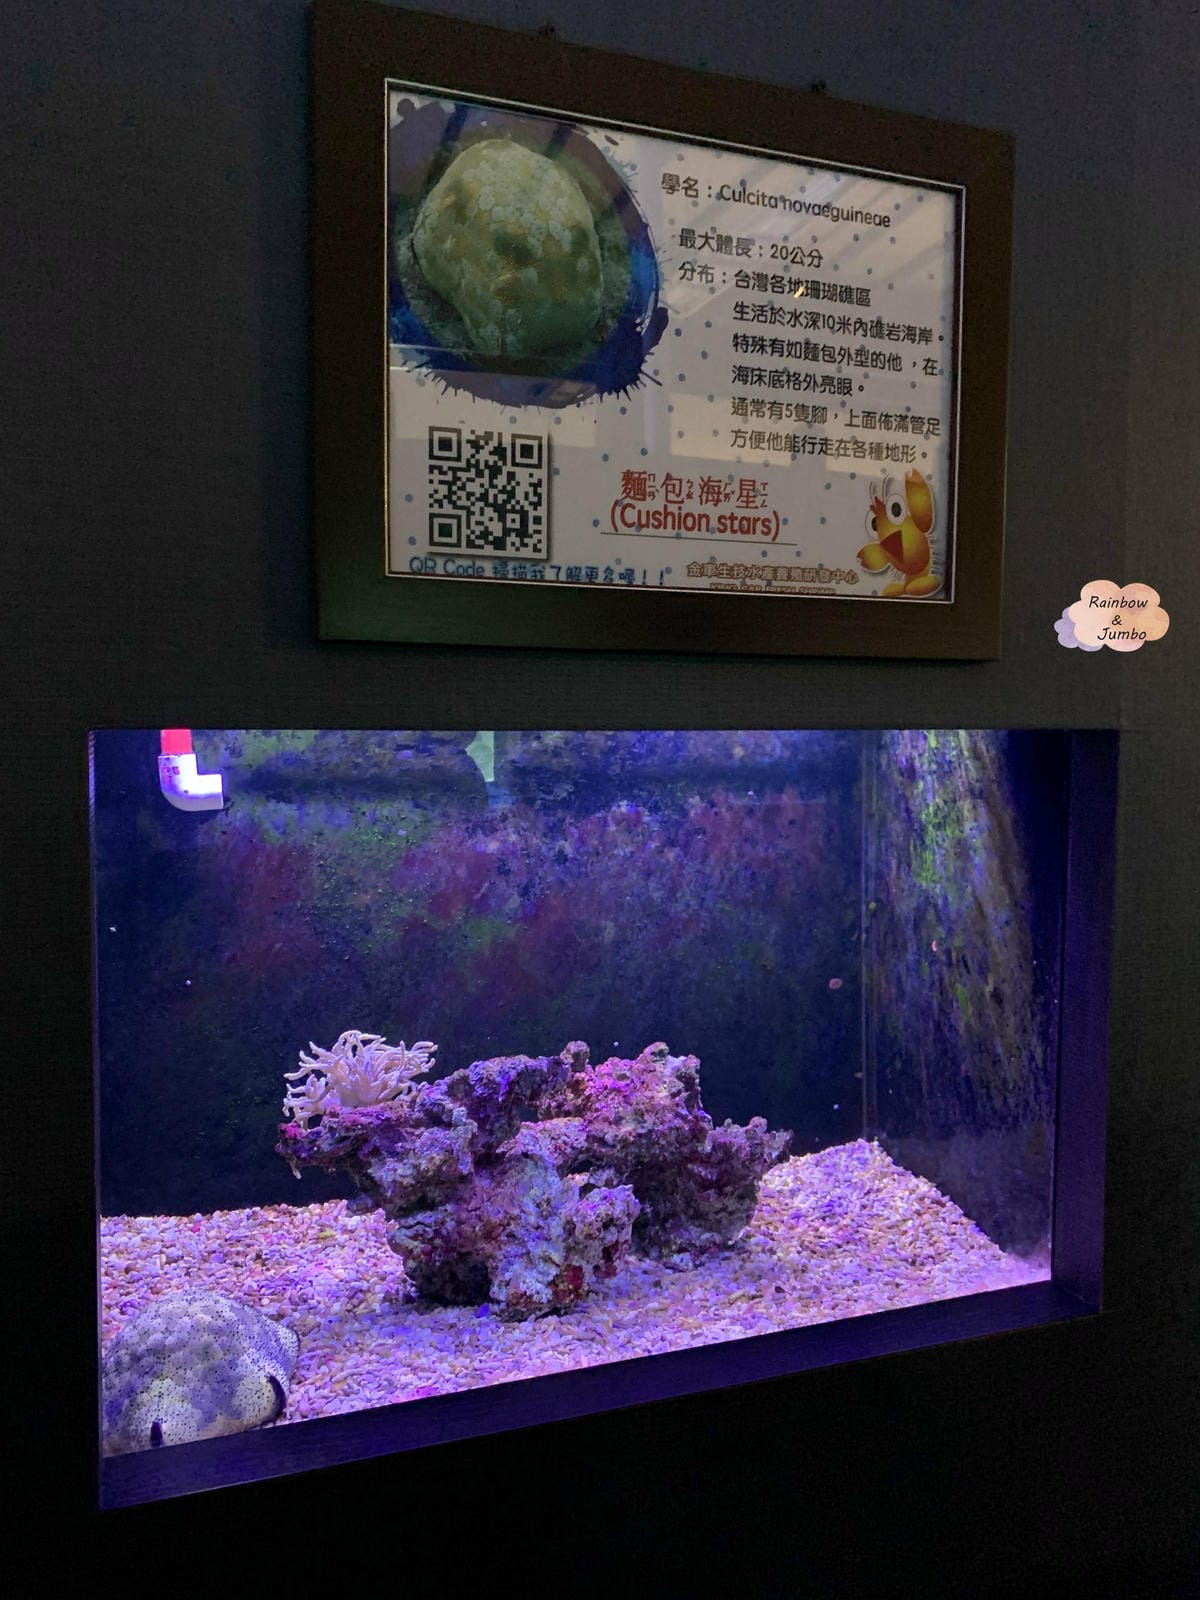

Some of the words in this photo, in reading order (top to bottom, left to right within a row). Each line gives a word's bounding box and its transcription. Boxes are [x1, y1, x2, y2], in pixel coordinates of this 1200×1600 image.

[783, 196, 891, 228] novaeguineae
[731, 365, 865, 397] 海床底格外亮眼。
[611, 499, 711, 532] (Cushion
[717, 510, 780, 542] stars)
[409, 556, 437, 574] QR
[443, 558, 485, 577] Code
